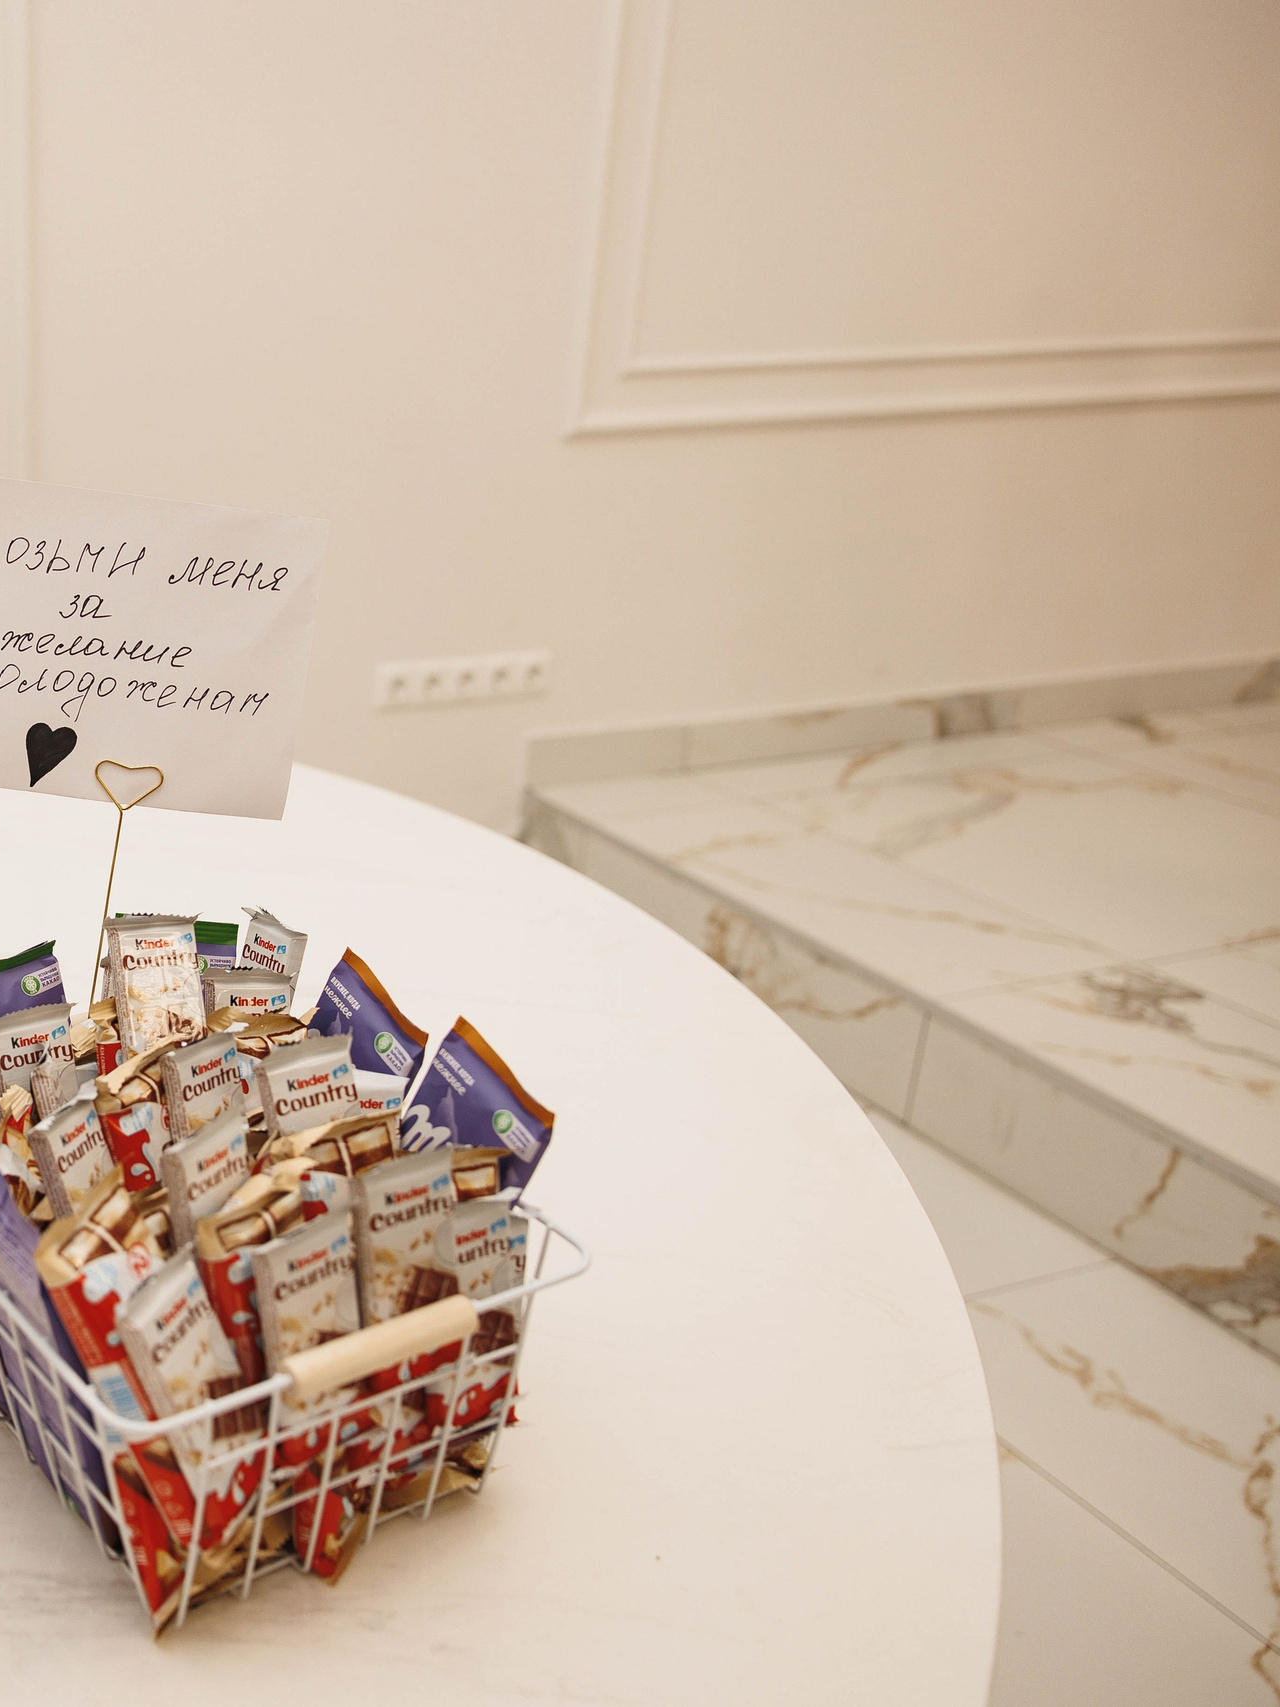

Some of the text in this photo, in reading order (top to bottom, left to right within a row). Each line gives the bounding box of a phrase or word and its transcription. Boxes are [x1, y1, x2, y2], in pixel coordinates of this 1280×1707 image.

[59, 594, 112, 619] за
[254, 933, 277, 952] Kinder
[123, 949, 199, 971] Country
[230, 995, 269, 1006] Kinder
[11, 1033, 50, 1049] Kinder
[191, 1057, 222, 1078] Kinder
[182, 1065, 241, 1102] Country
[287, 1072, 330, 1092] Kinder
[275, 1083, 358, 1116] Country
[360, 1098, 384, 1110] nder
[57, 1130, 106, 1174] Country
[370, 1193, 457, 1232] Country
[455, 1227, 488, 1246] inder
[458, 1236, 512, 1264] untry
